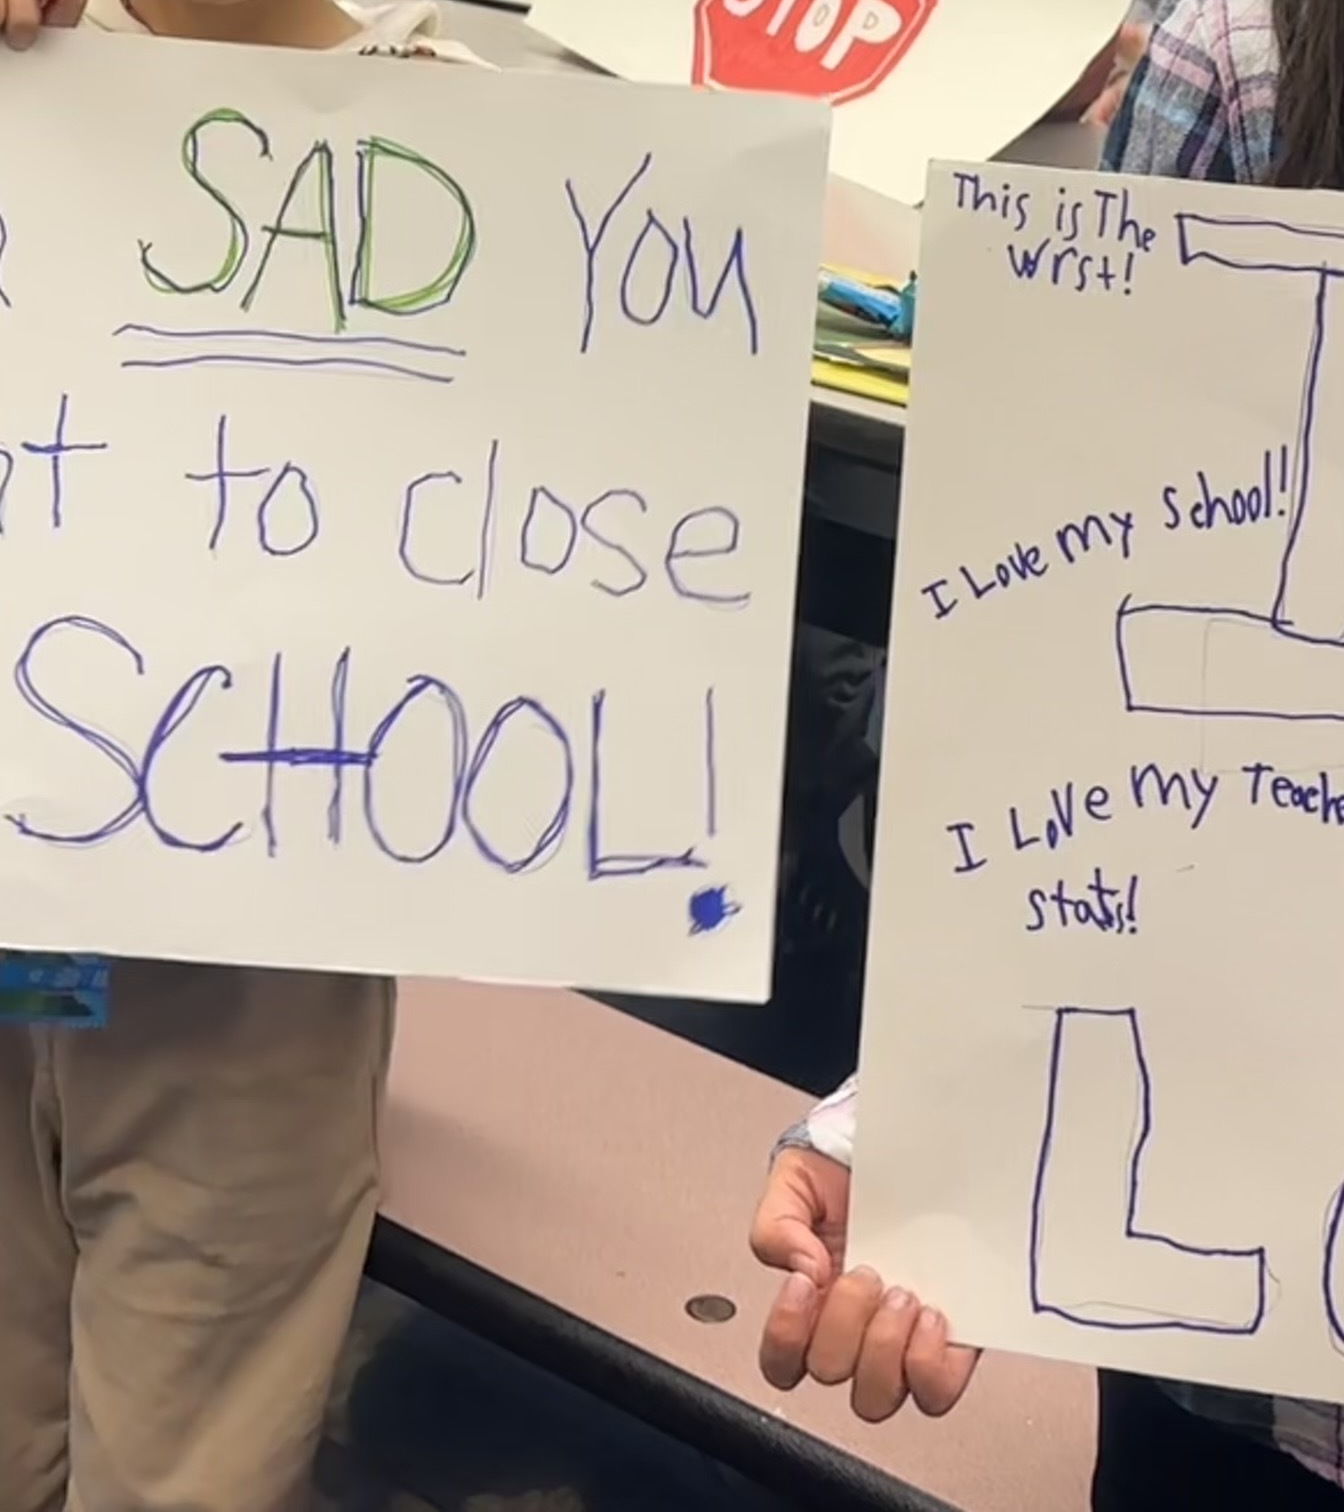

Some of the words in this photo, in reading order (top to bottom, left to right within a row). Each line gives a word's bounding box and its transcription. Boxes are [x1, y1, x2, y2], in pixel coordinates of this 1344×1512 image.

[138, 106, 477, 332] SAD
[564, 152, 762, 356] You
[953, 171, 1030, 232] This
[1056, 186, 1083, 241] is
[1094, 187, 1157, 252] The
[184, 413, 320, 559] to
[398, 438, 753, 608] close
[921, 578, 958, 619] I
[6, 612, 738, 936] SCHOOL!
[946, 822, 988, 873] I
